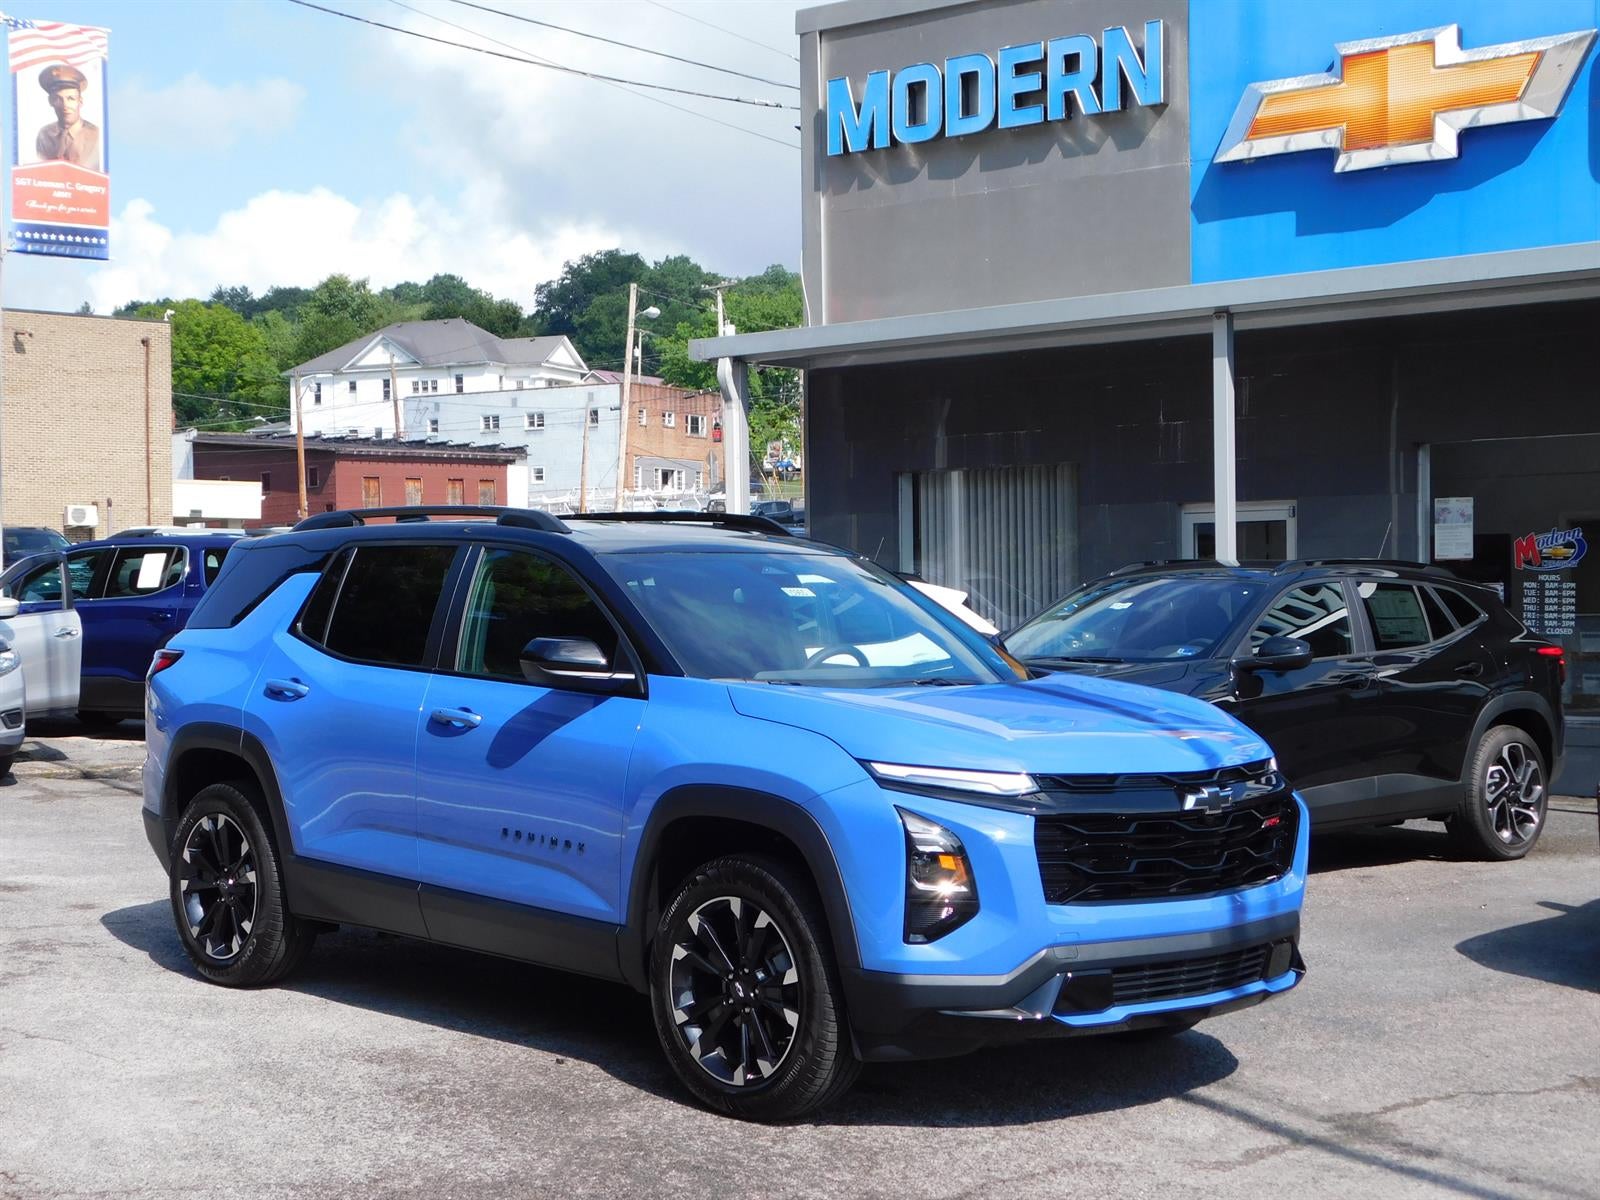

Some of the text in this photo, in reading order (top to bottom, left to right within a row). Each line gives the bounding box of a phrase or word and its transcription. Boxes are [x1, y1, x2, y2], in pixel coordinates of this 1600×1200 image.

[827, 19, 1164, 156] MODERN
[1514, 527, 1583, 570] Modern
[1546, 627, 1574, 635] CLOSED
